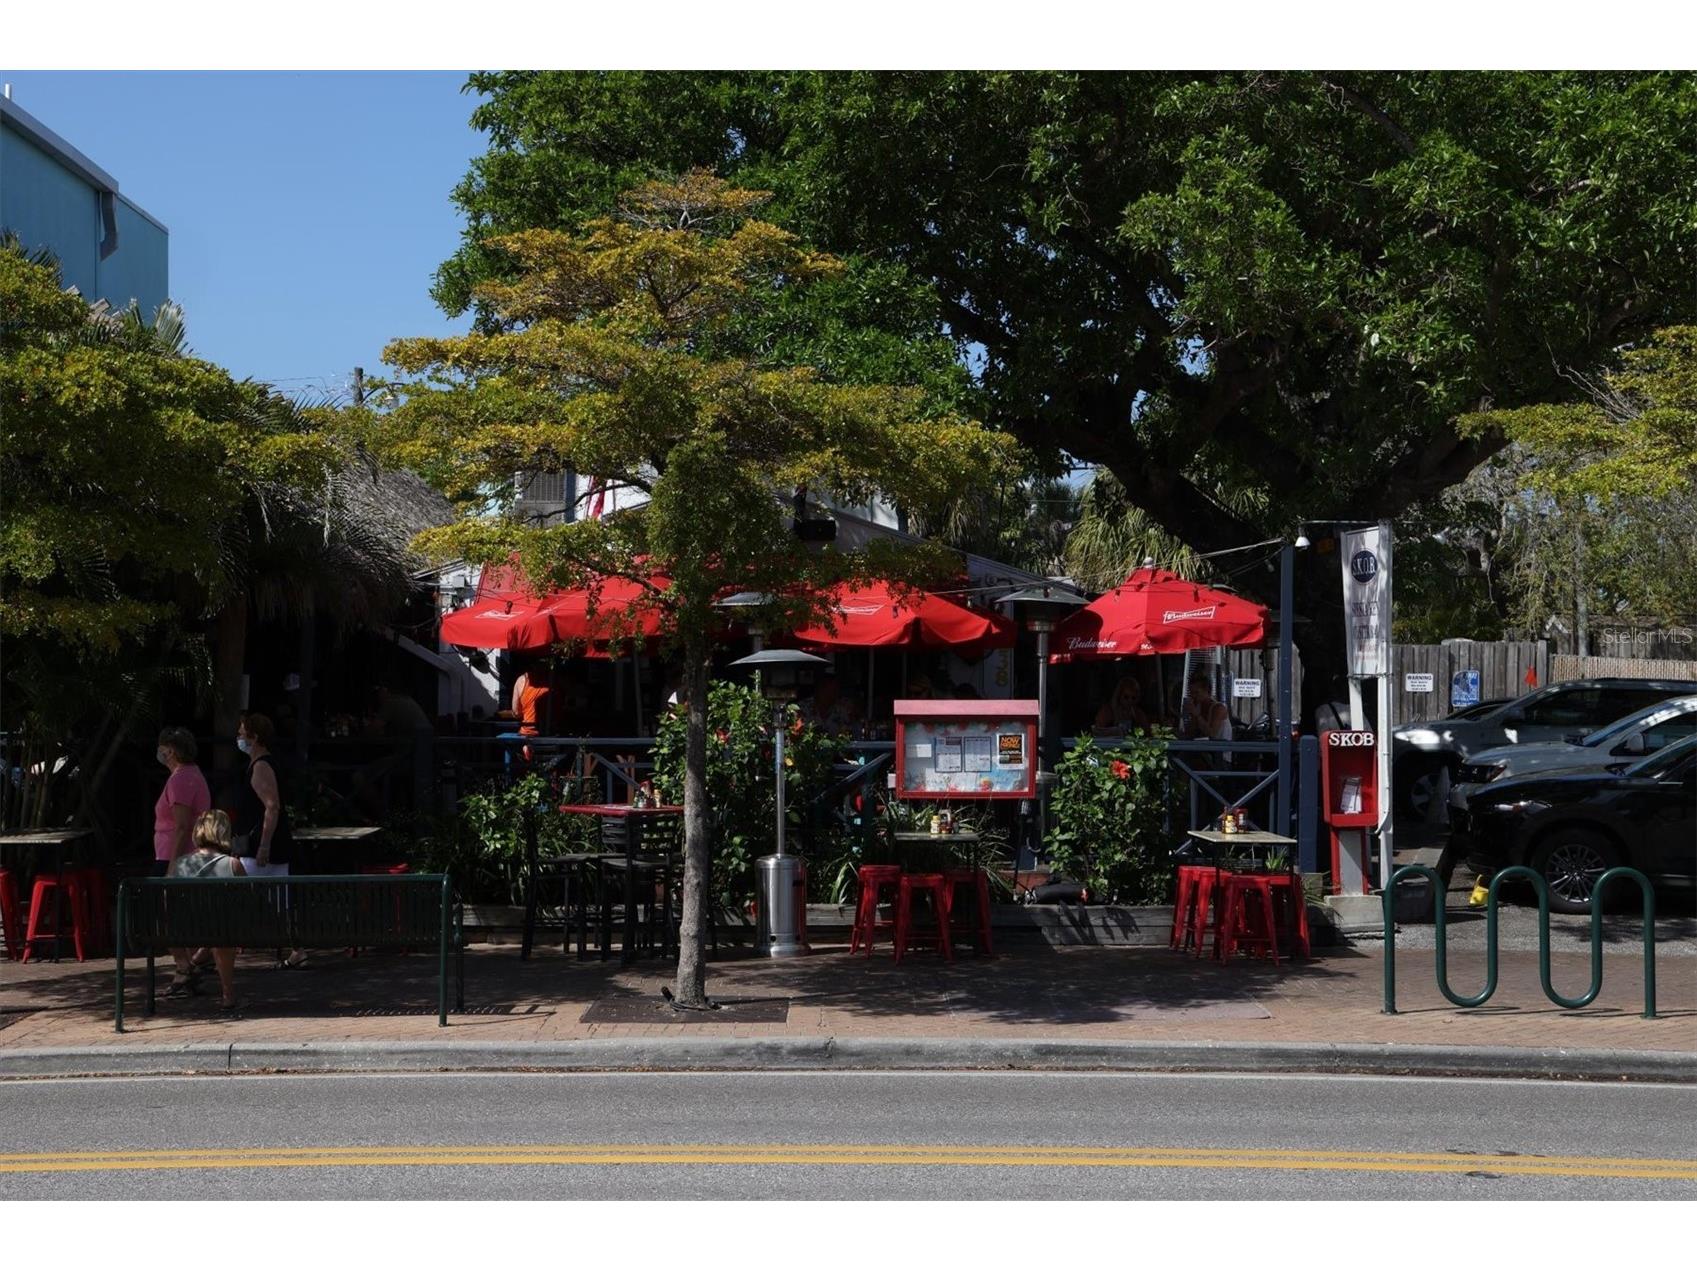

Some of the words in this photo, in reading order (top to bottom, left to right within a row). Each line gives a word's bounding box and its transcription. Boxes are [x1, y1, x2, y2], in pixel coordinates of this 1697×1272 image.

[1166, 607, 1214, 621] Budweiser
[1066, 637, 1116, 650] Budweiser
[1001, 736, 1019, 745] NOW
[1329, 732, 1375, 747] SKOB
